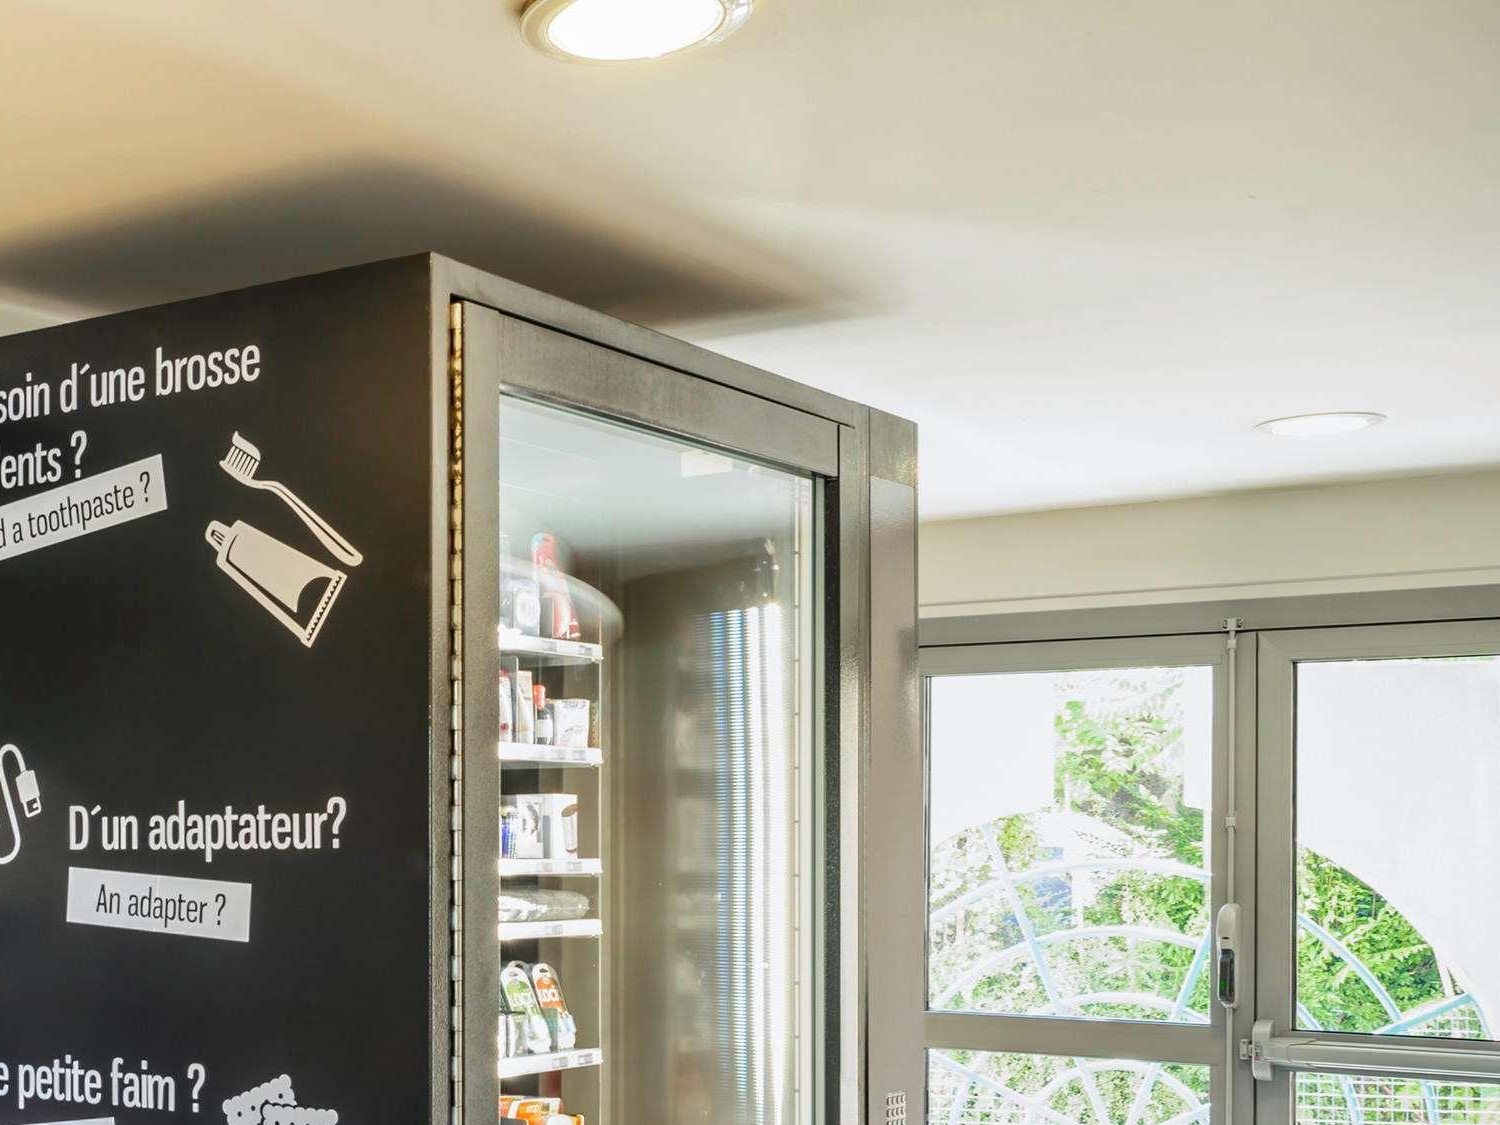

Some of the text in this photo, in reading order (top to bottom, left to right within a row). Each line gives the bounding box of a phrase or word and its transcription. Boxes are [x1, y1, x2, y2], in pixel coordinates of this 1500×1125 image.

[155, 344, 262, 397] brosse
[12, 521, 24, 544] a
[27, 484, 135, 538] toothpaste
[148, 796, 348, 863] adaptateur?
[95, 883, 121, 914] An
[128, 887, 208, 929] adapter
[18, 1054, 102, 1110] petite
[110, 1057, 176, 1112] faim
